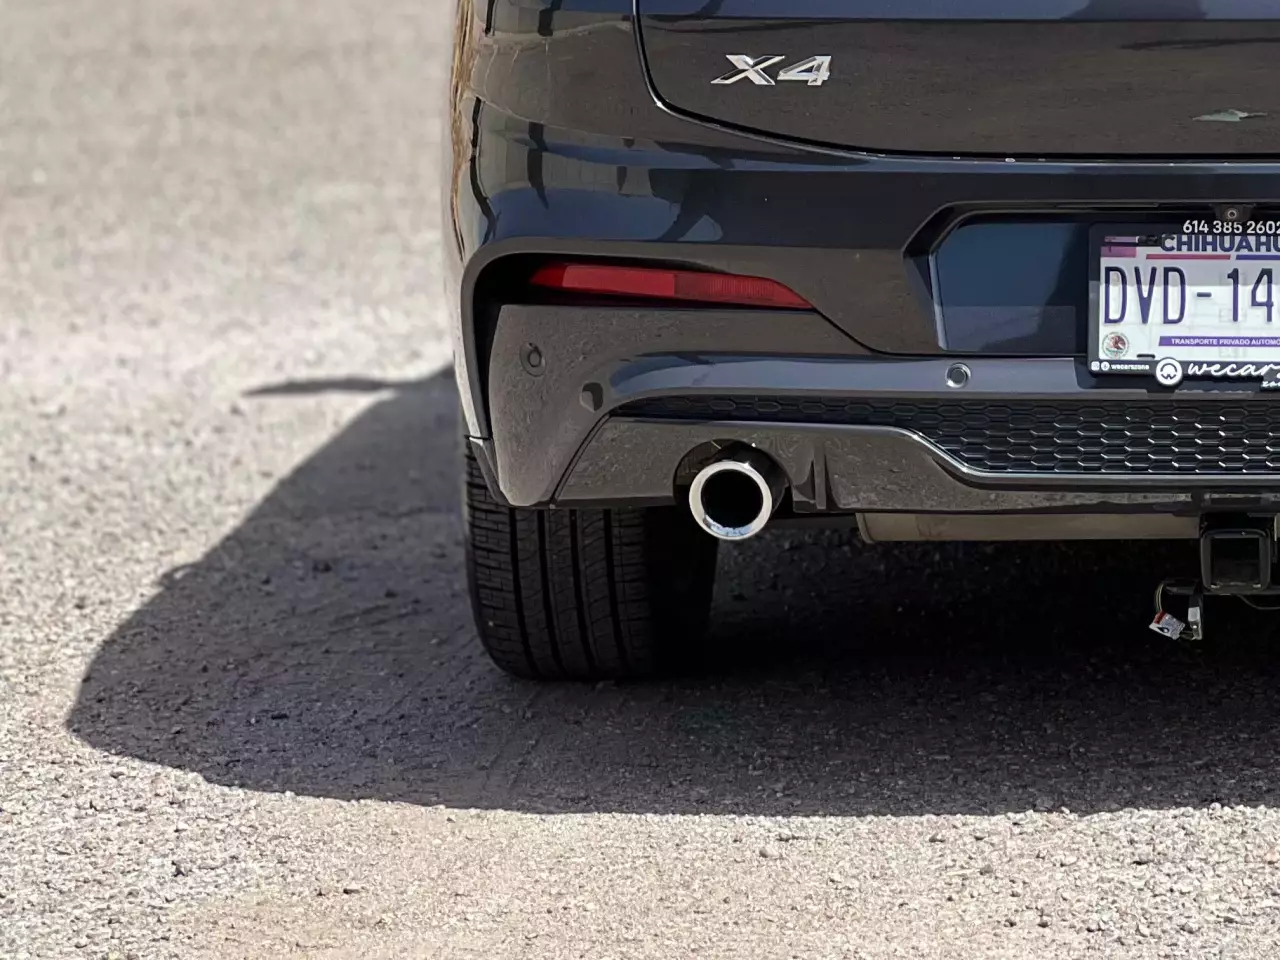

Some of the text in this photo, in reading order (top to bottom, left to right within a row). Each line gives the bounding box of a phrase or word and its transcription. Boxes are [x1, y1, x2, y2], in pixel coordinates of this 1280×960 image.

[711, 54, 831, 85] X4
[1183, 220, 1209, 233] 614
[1212, 220, 1243, 234] 385
[1219, 338, 1250, 346] PRIVADO
